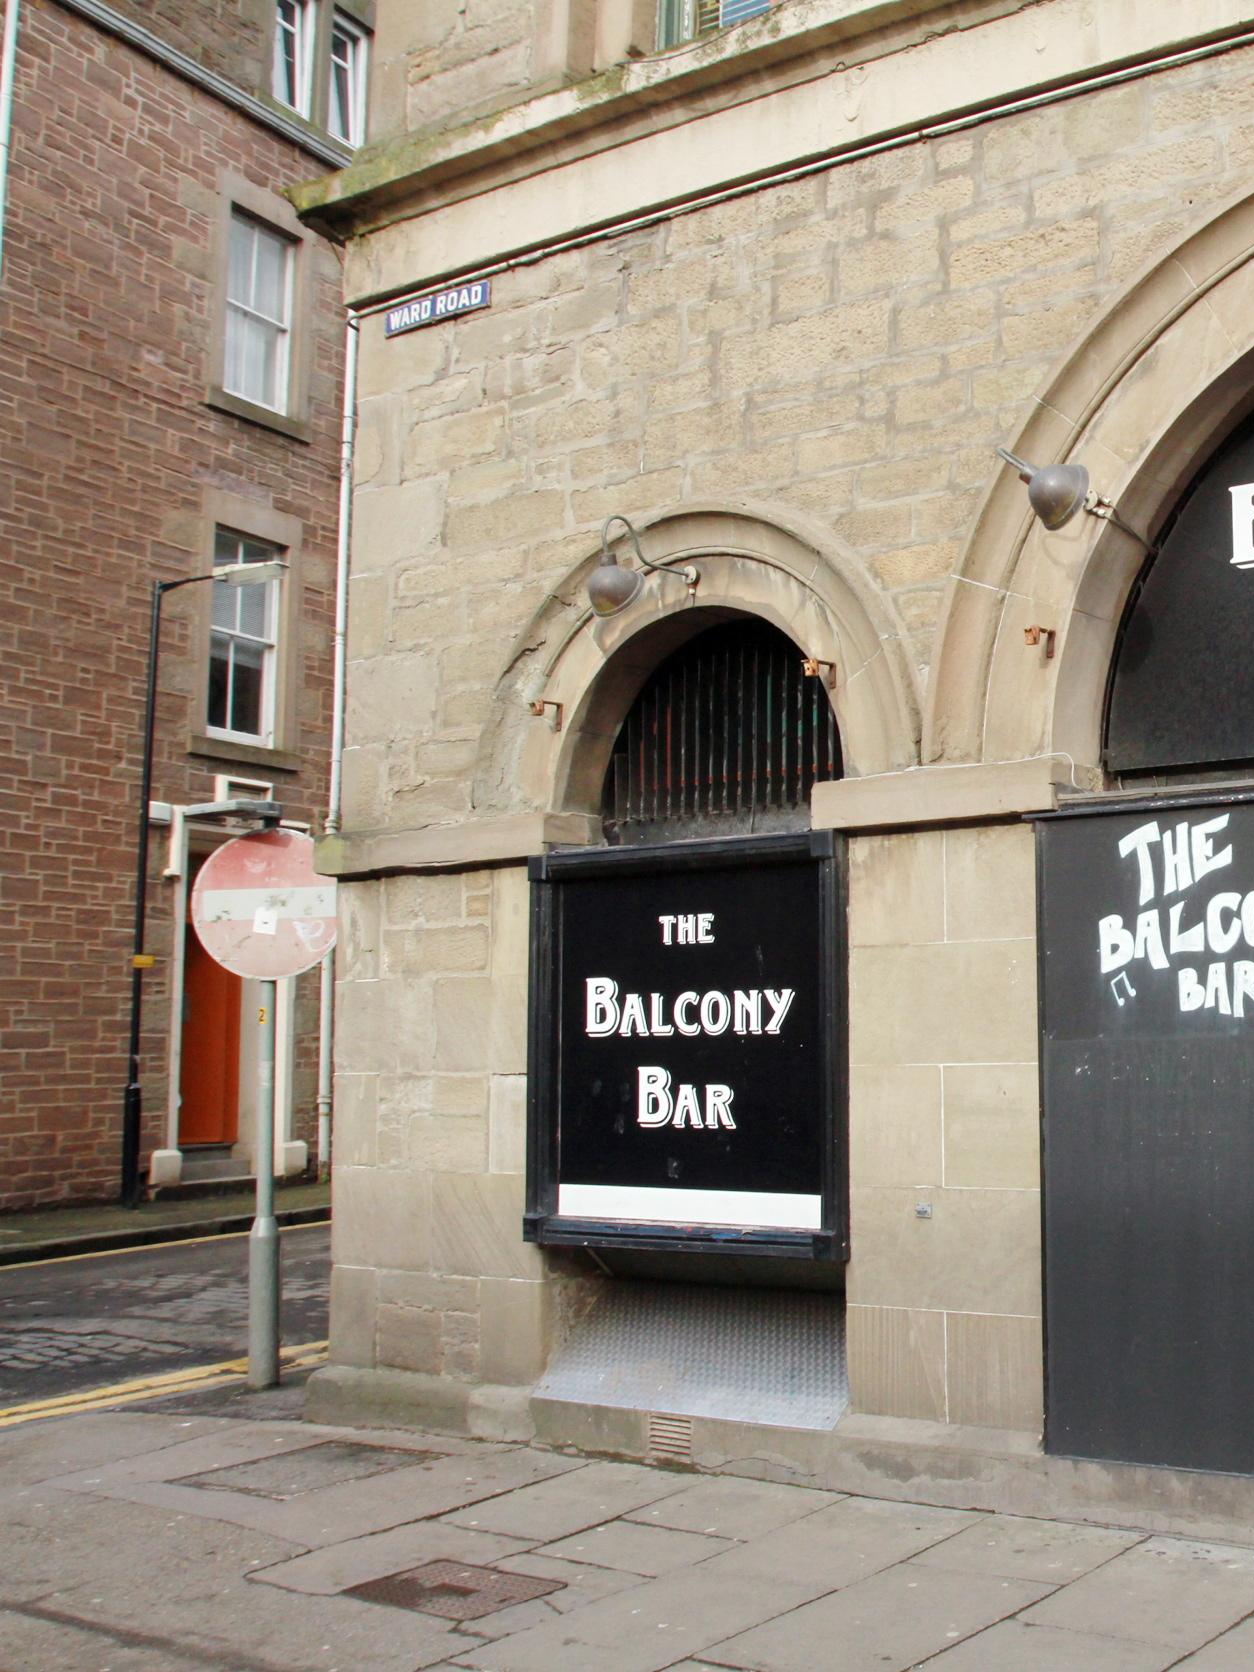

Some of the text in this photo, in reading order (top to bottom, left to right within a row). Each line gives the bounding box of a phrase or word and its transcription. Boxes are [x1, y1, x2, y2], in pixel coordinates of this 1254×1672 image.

[389, 284, 482, 330] WARD ROAD
[1118, 812, 1233, 906] THE
[658, 912, 715, 945] THE
[585, 976, 795, 1038] BALCONY
[637, 1065, 736, 1129] BAR
